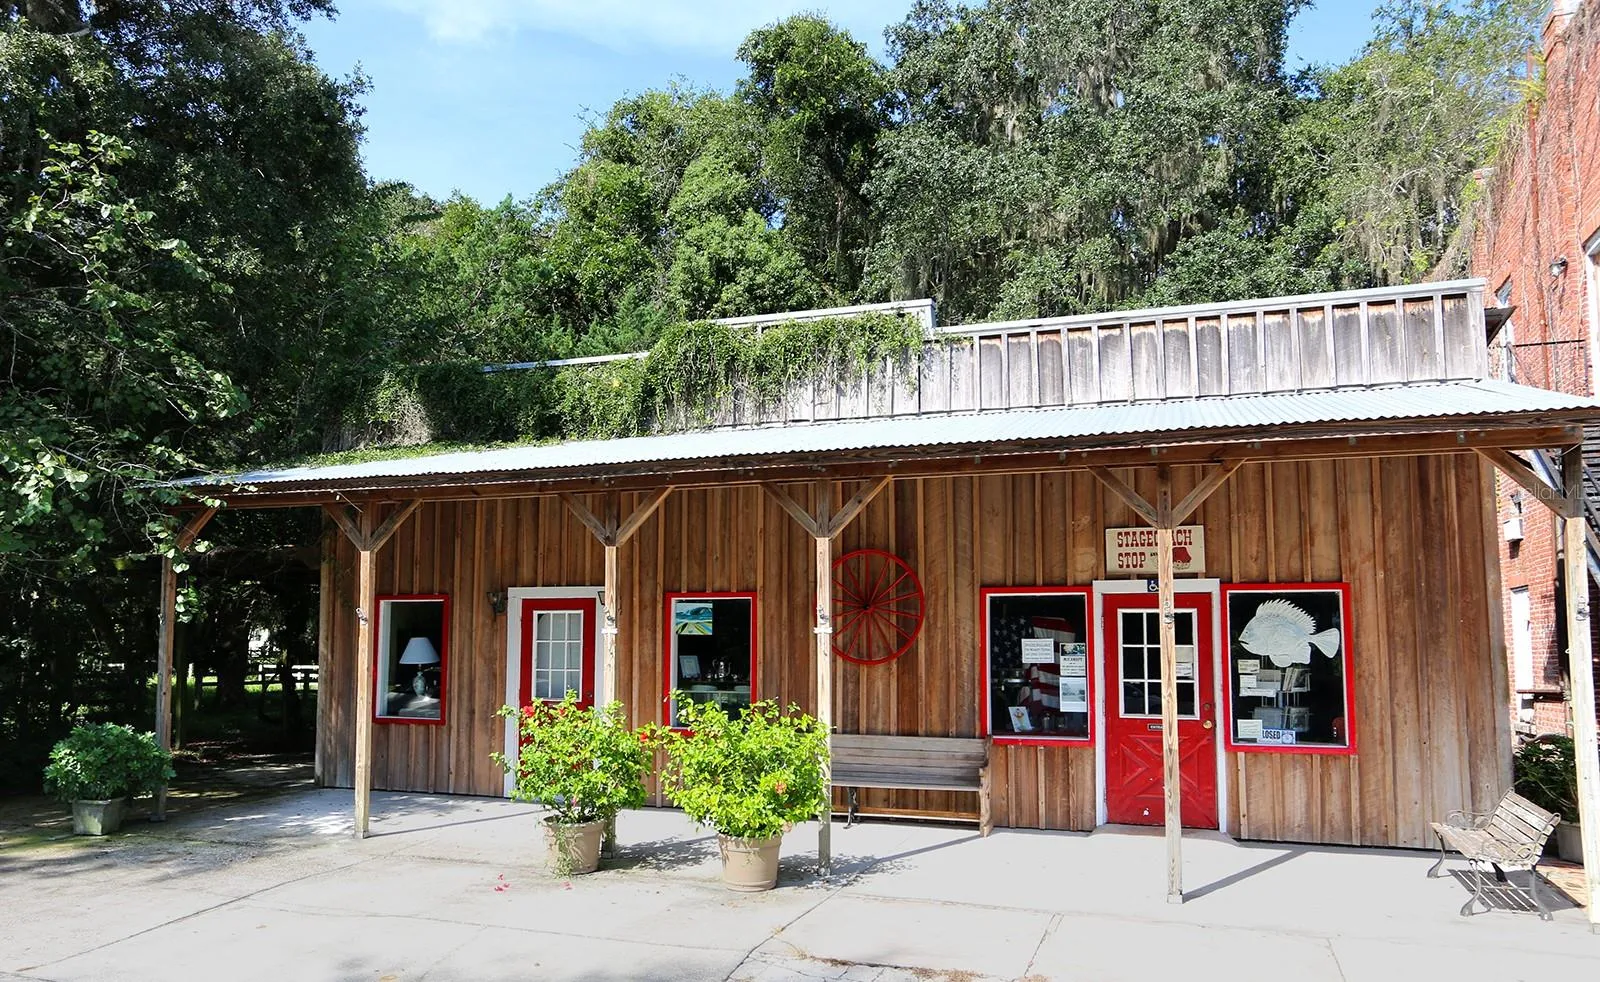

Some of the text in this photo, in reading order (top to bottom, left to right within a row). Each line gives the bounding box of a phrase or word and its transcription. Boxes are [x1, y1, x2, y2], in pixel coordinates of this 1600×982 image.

[1117, 530, 1192, 547] STAGECACH
[1118, 552, 1146, 568] STOP
[1262, 729, 1281, 740] LOSED
